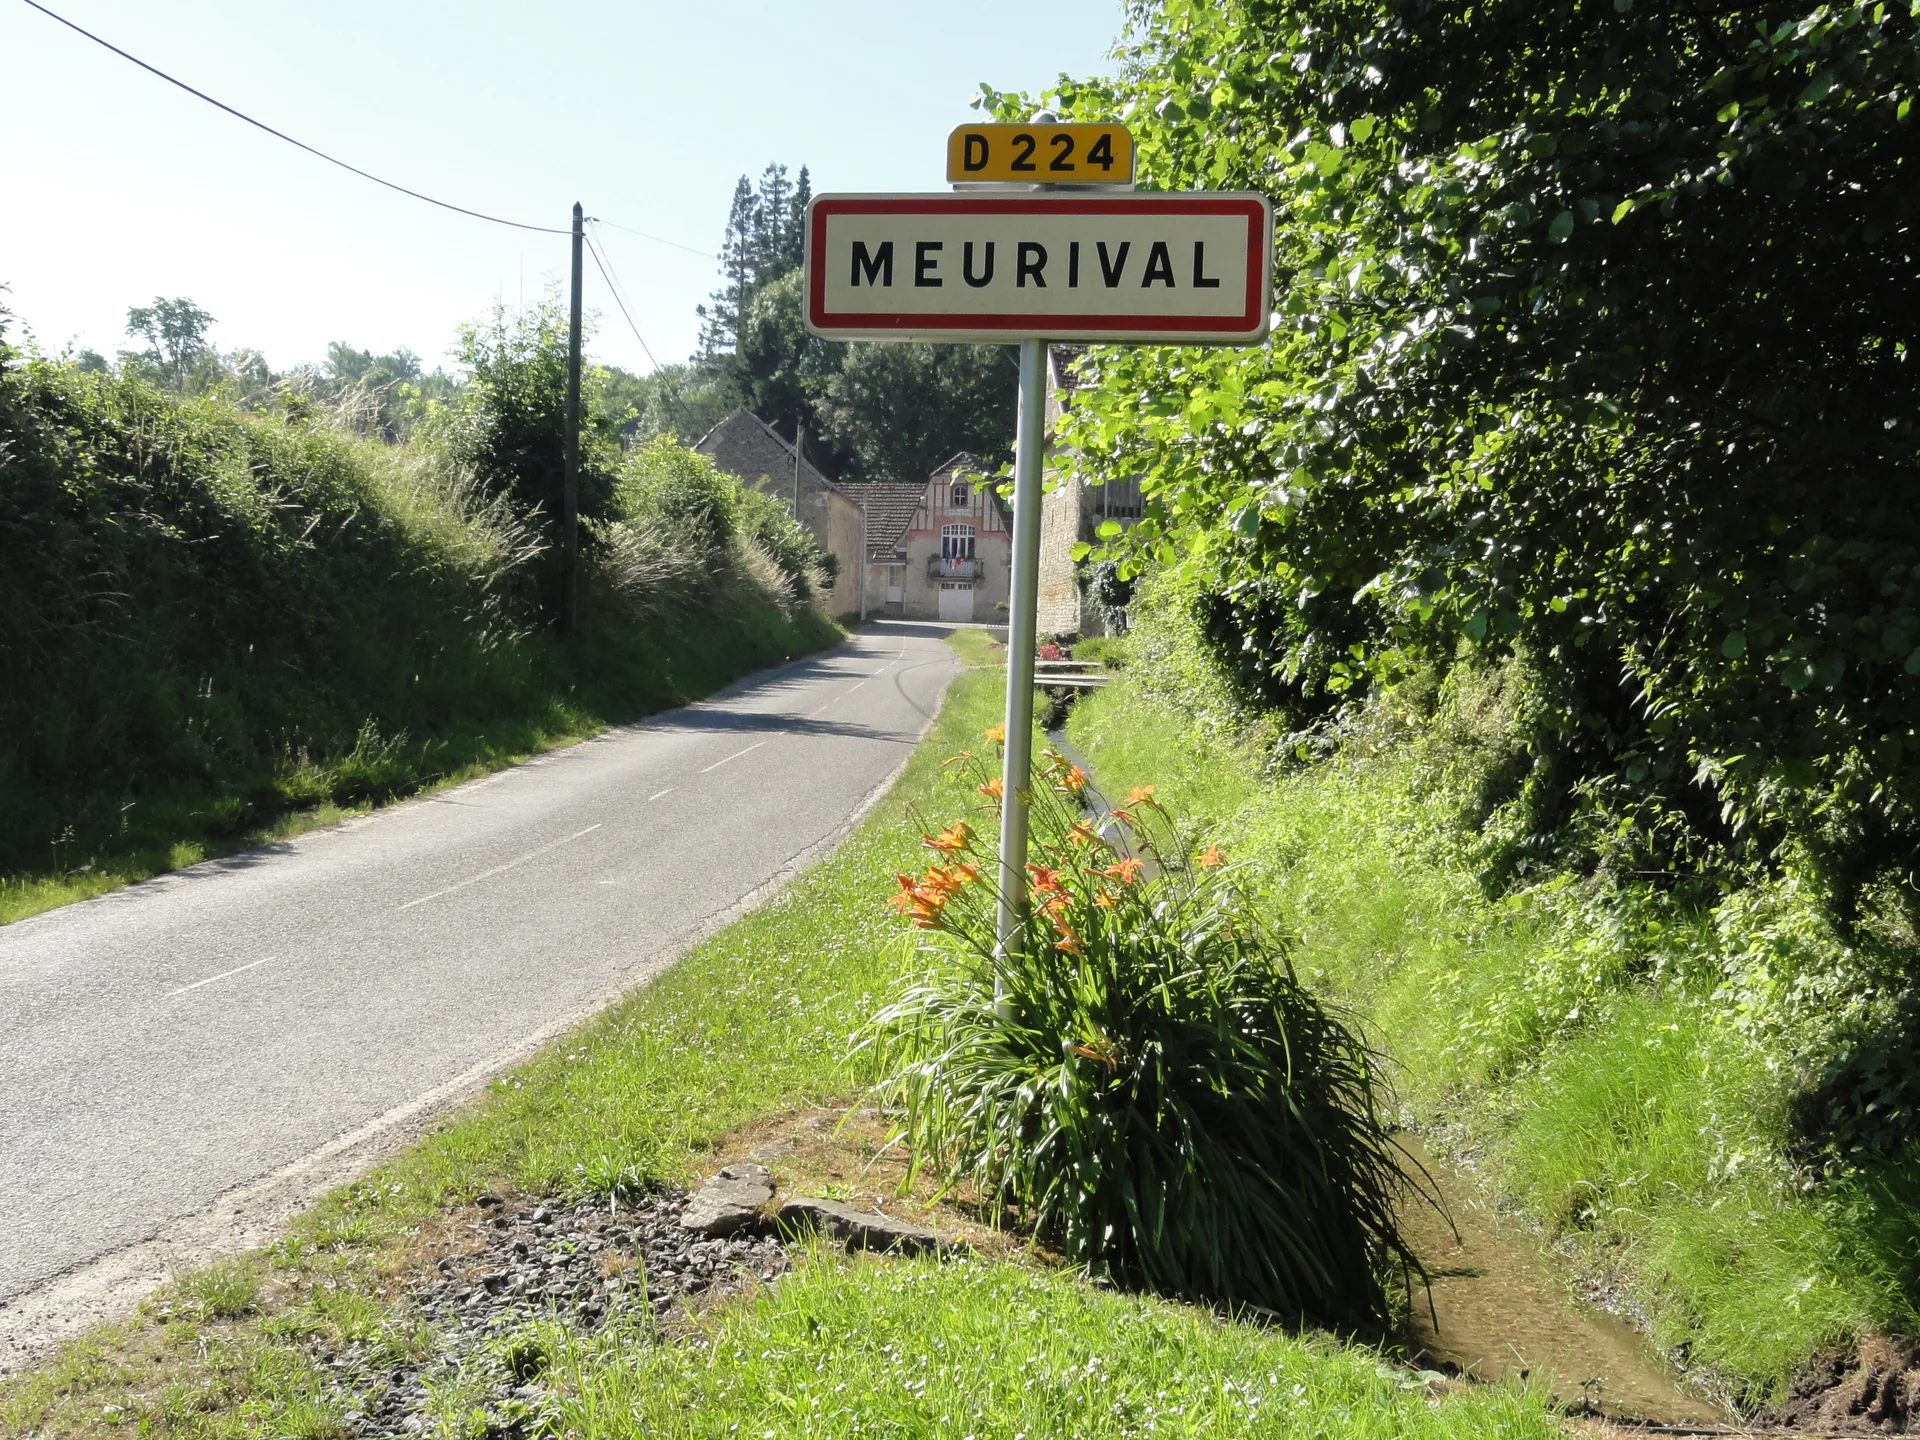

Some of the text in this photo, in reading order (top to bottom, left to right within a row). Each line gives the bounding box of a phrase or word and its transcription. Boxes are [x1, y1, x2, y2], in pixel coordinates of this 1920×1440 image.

[964, 134, 1114, 171] D 224
[851, 241, 1220, 288] MEURIVAL
